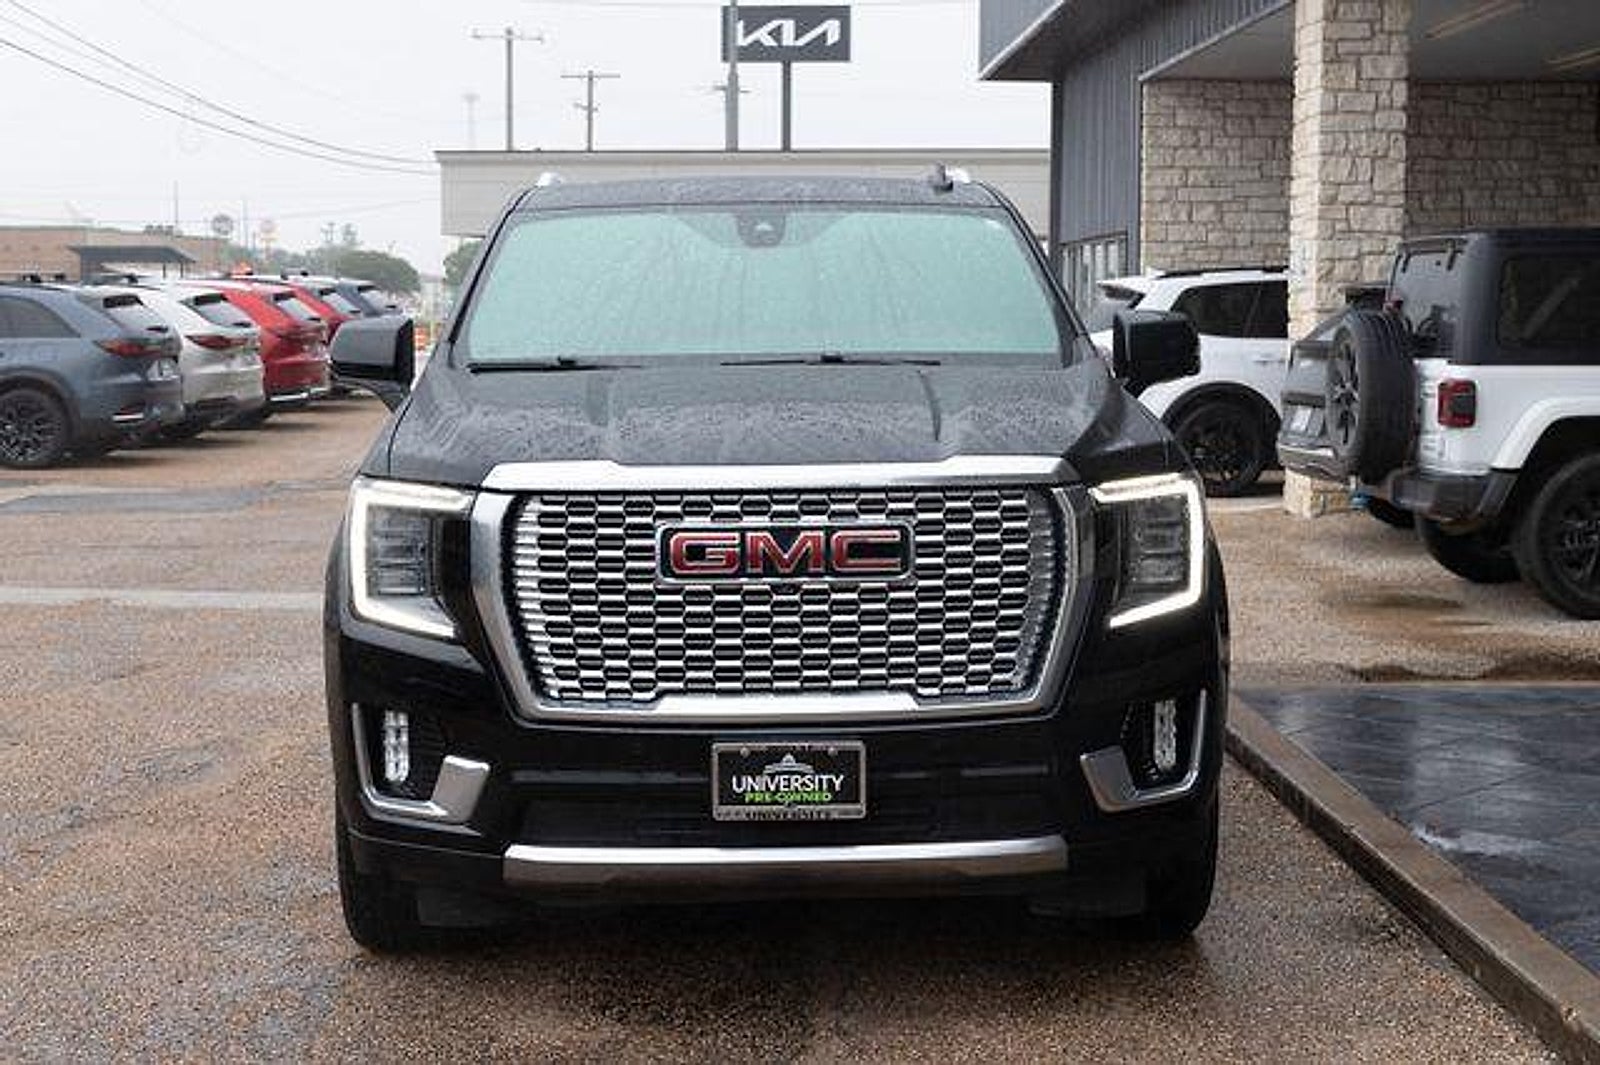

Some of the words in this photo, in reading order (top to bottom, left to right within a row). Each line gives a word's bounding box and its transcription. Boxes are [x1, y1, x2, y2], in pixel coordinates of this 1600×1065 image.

[737, 19, 840, 46] KIA
[669, 530, 901, 574] GMC
[732, 775, 844, 792] UNIVERSITY
